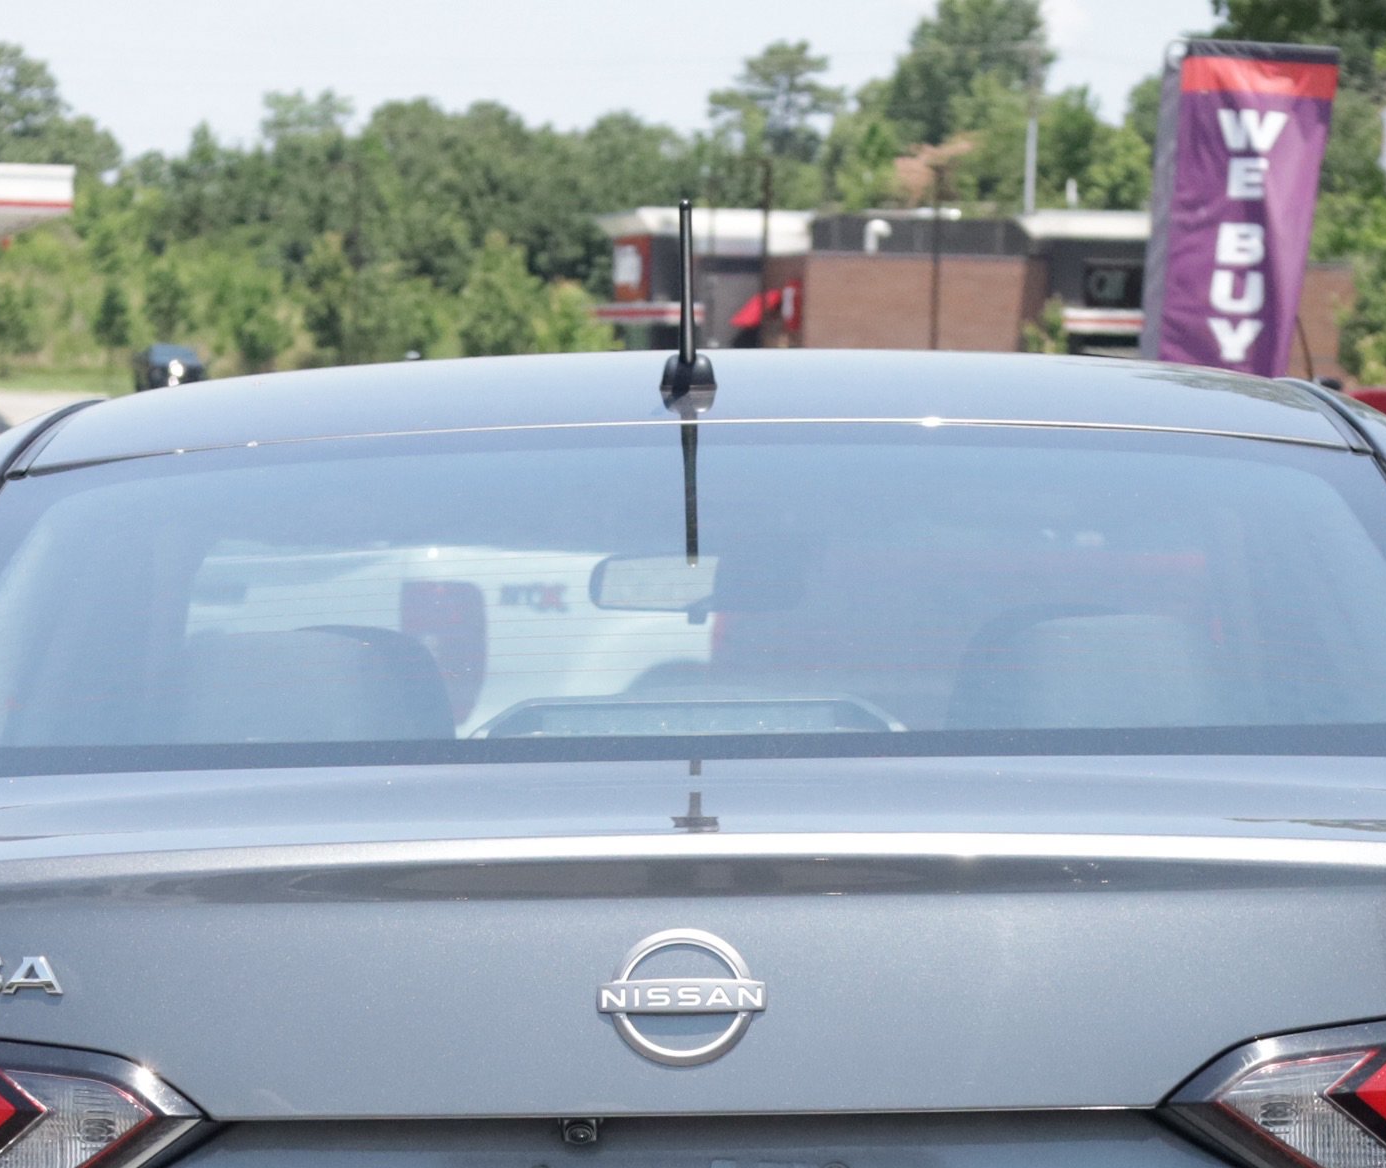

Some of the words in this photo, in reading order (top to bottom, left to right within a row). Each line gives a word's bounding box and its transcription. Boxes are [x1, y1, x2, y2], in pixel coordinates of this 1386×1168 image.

[1217, 108, 1289, 200] WE
[1208, 222, 1266, 363] BUY
[600, 986, 763, 1009] NISSAN
